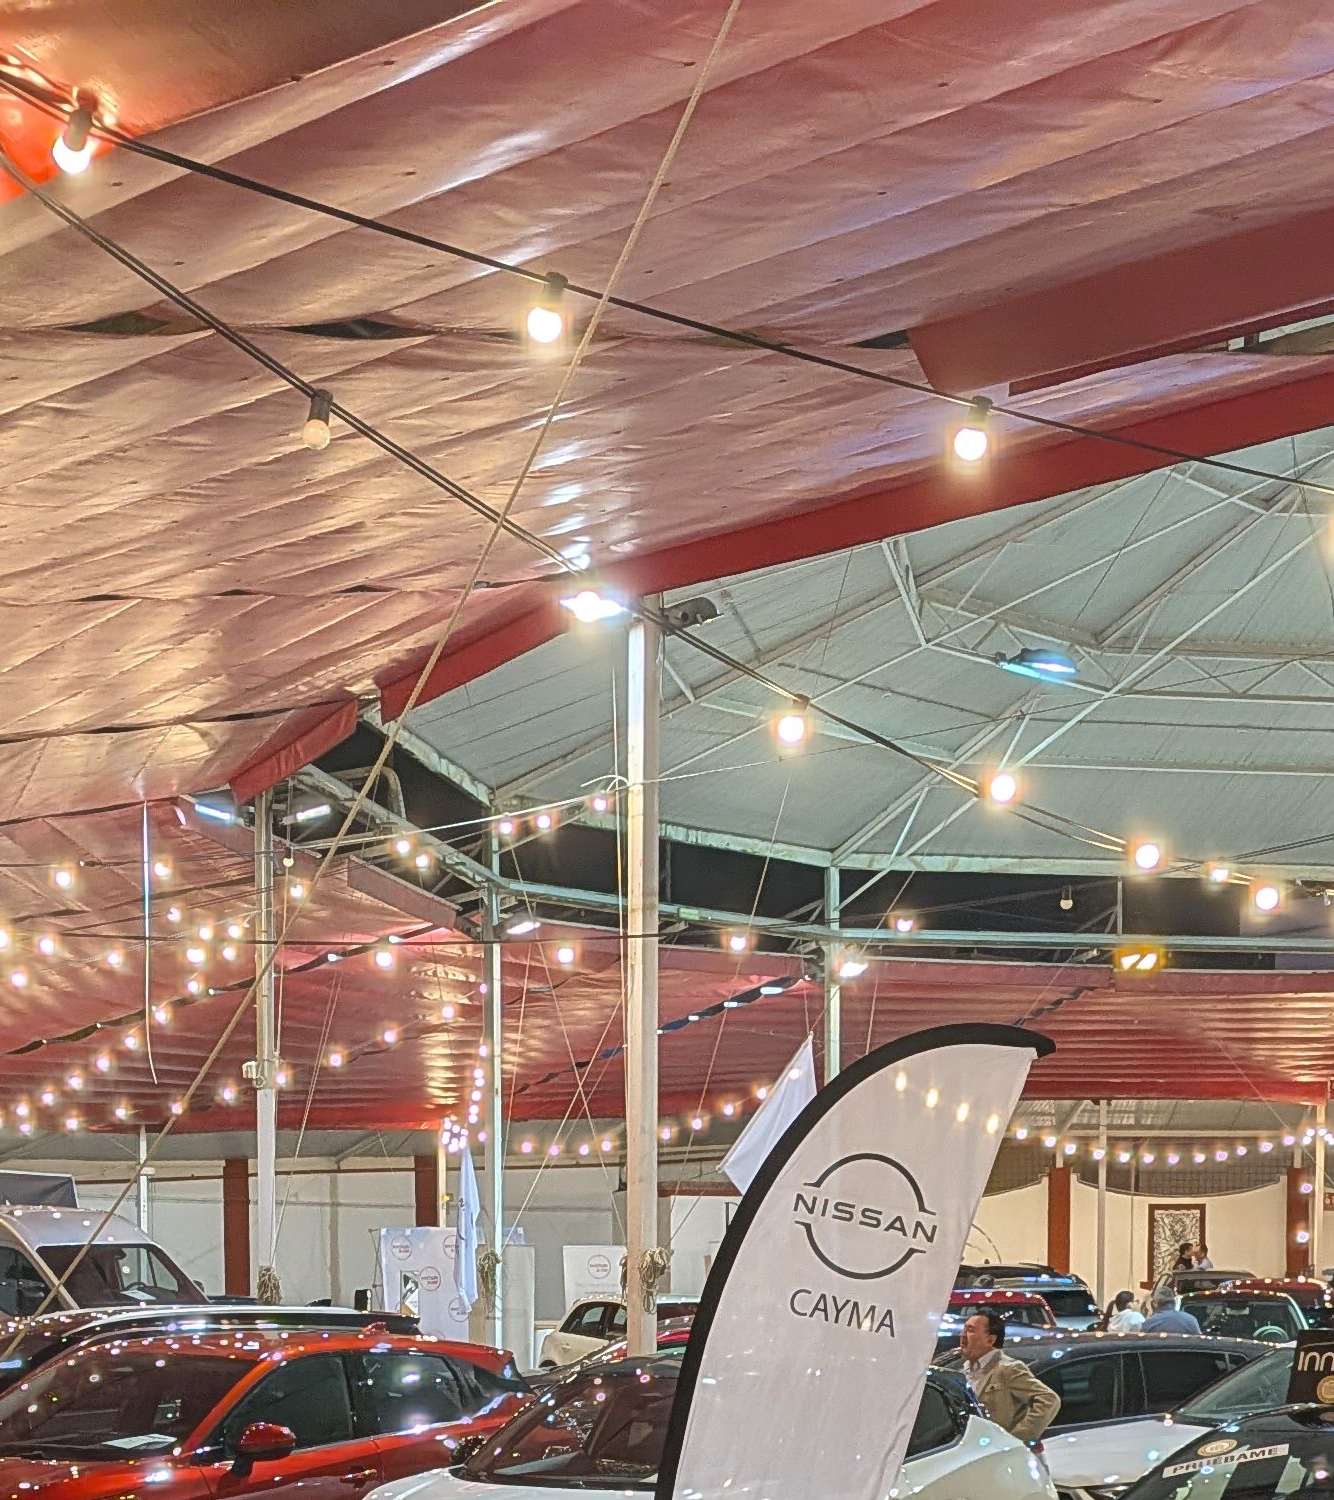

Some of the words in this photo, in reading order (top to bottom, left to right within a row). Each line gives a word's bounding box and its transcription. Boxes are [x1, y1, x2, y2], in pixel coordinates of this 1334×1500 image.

[793, 1193, 938, 1243] NISSAN
[789, 1288, 896, 1338] CAYMA
[1172, 1445, 1279, 1475] PRUEBAME
